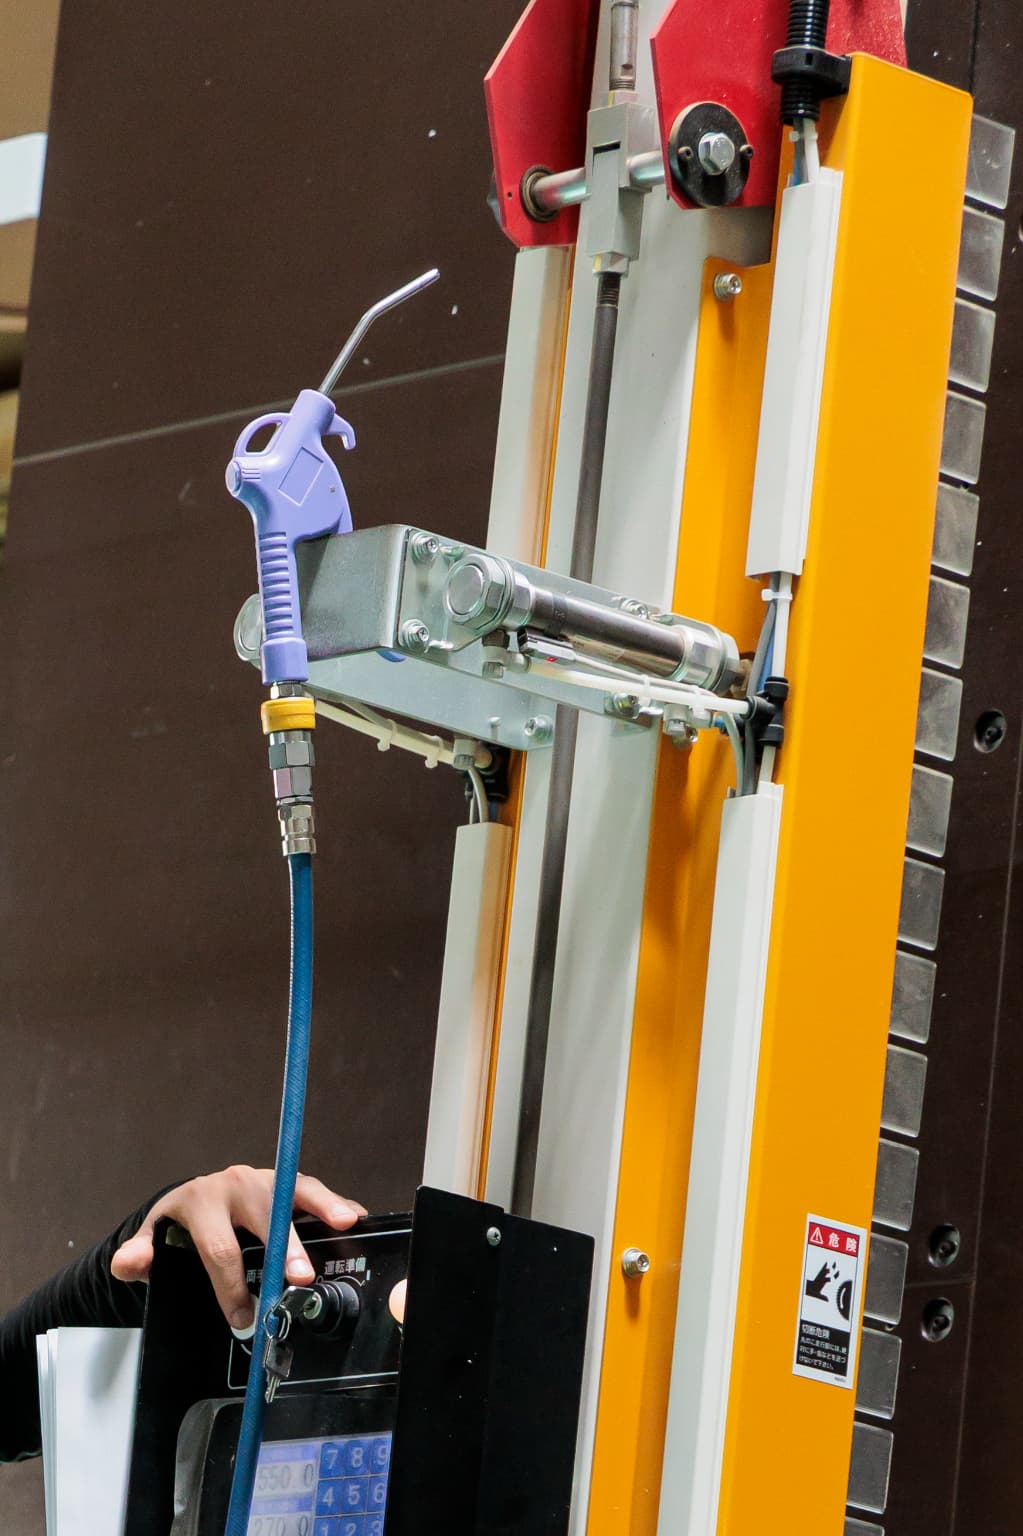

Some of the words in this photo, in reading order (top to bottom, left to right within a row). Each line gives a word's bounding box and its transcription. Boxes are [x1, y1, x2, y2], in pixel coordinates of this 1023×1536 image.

[828, 1233, 857, 1252] 危険
[324, 1257, 367, 1275] 運転準備
[327, 1449, 338, 1470] 7
[351, 1447, 364, 1468] 8
[377, 1445, 388, 1466] 9
[322, 1487, 334, 1507] 4
[347, 1484, 361, 1505] 5
[373, 1482, 385, 1503] 6
